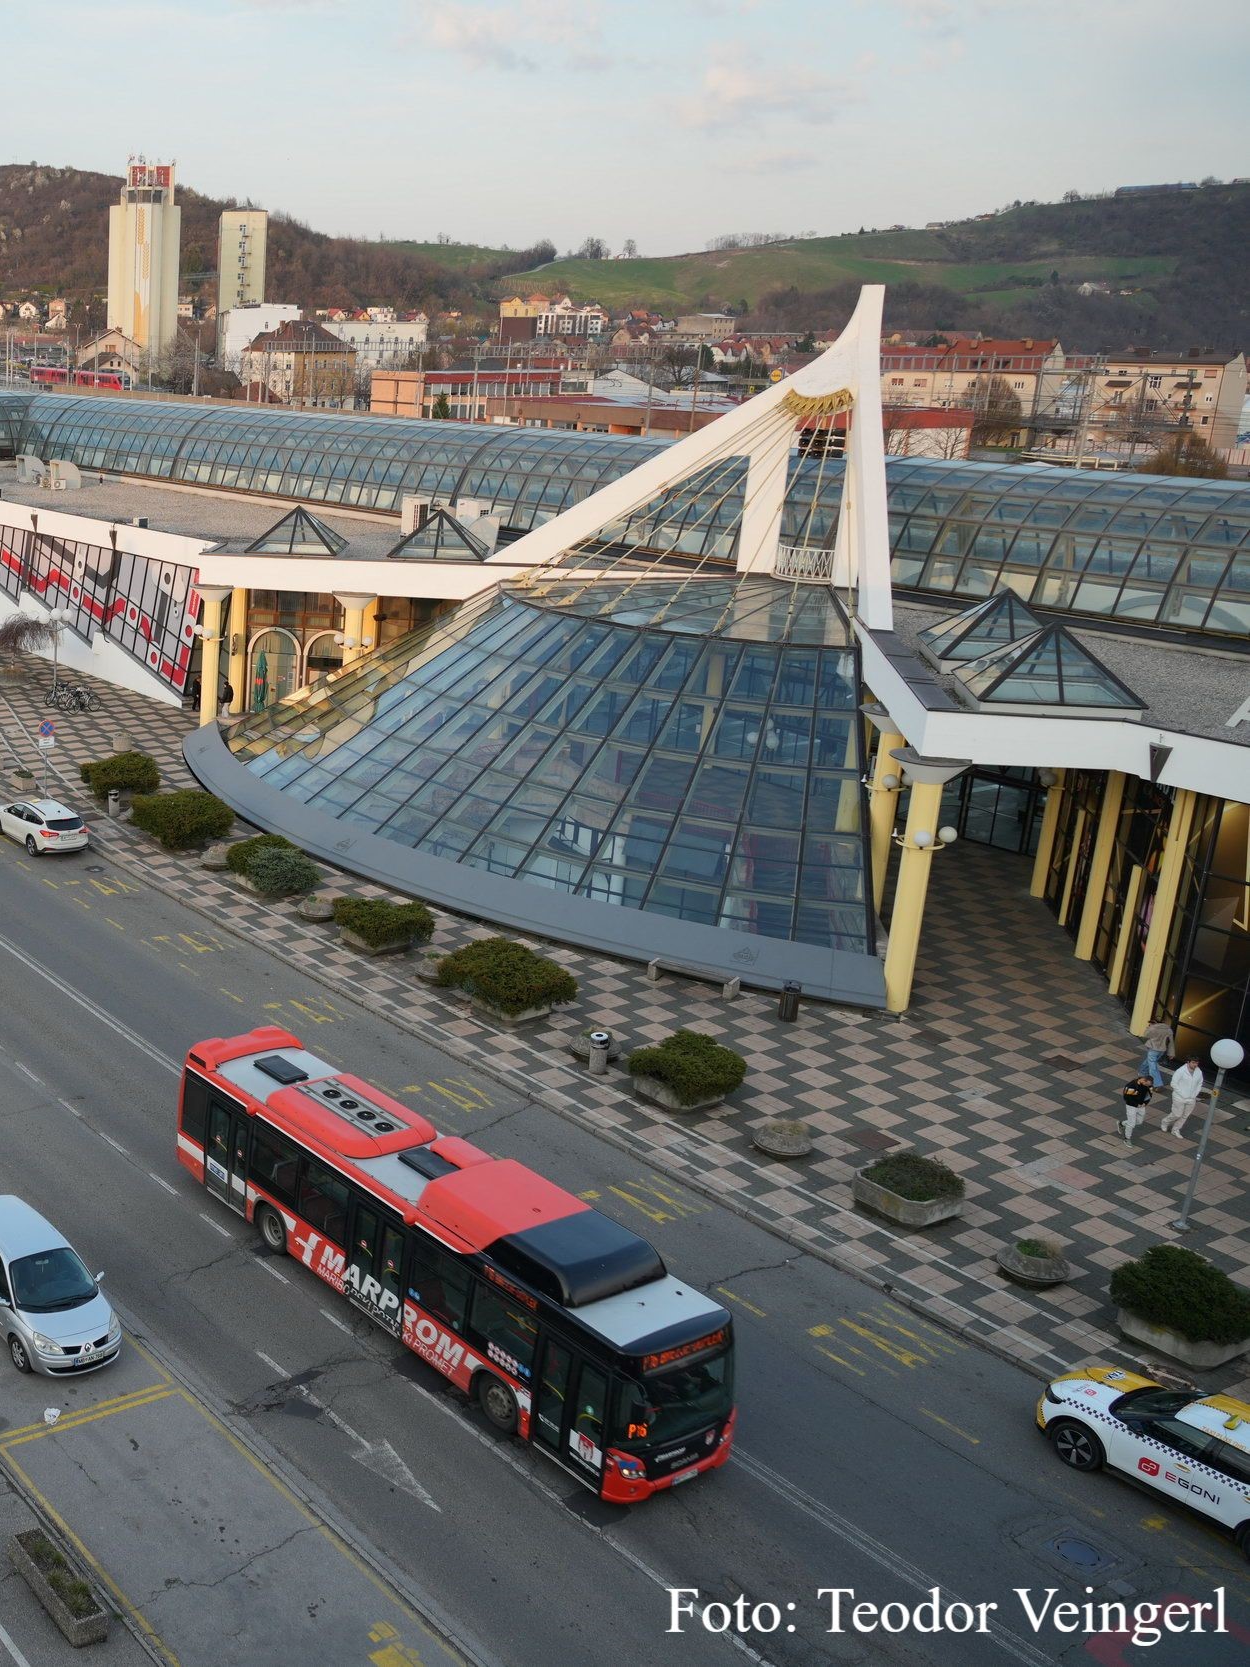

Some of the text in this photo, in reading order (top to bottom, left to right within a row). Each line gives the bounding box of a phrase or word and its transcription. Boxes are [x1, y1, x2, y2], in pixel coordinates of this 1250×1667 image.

[320, 1245, 465, 1367] MARPROM
[413, 1338, 457, 1375] PROMET
[1165, 1471, 1221, 1505] EGONI
